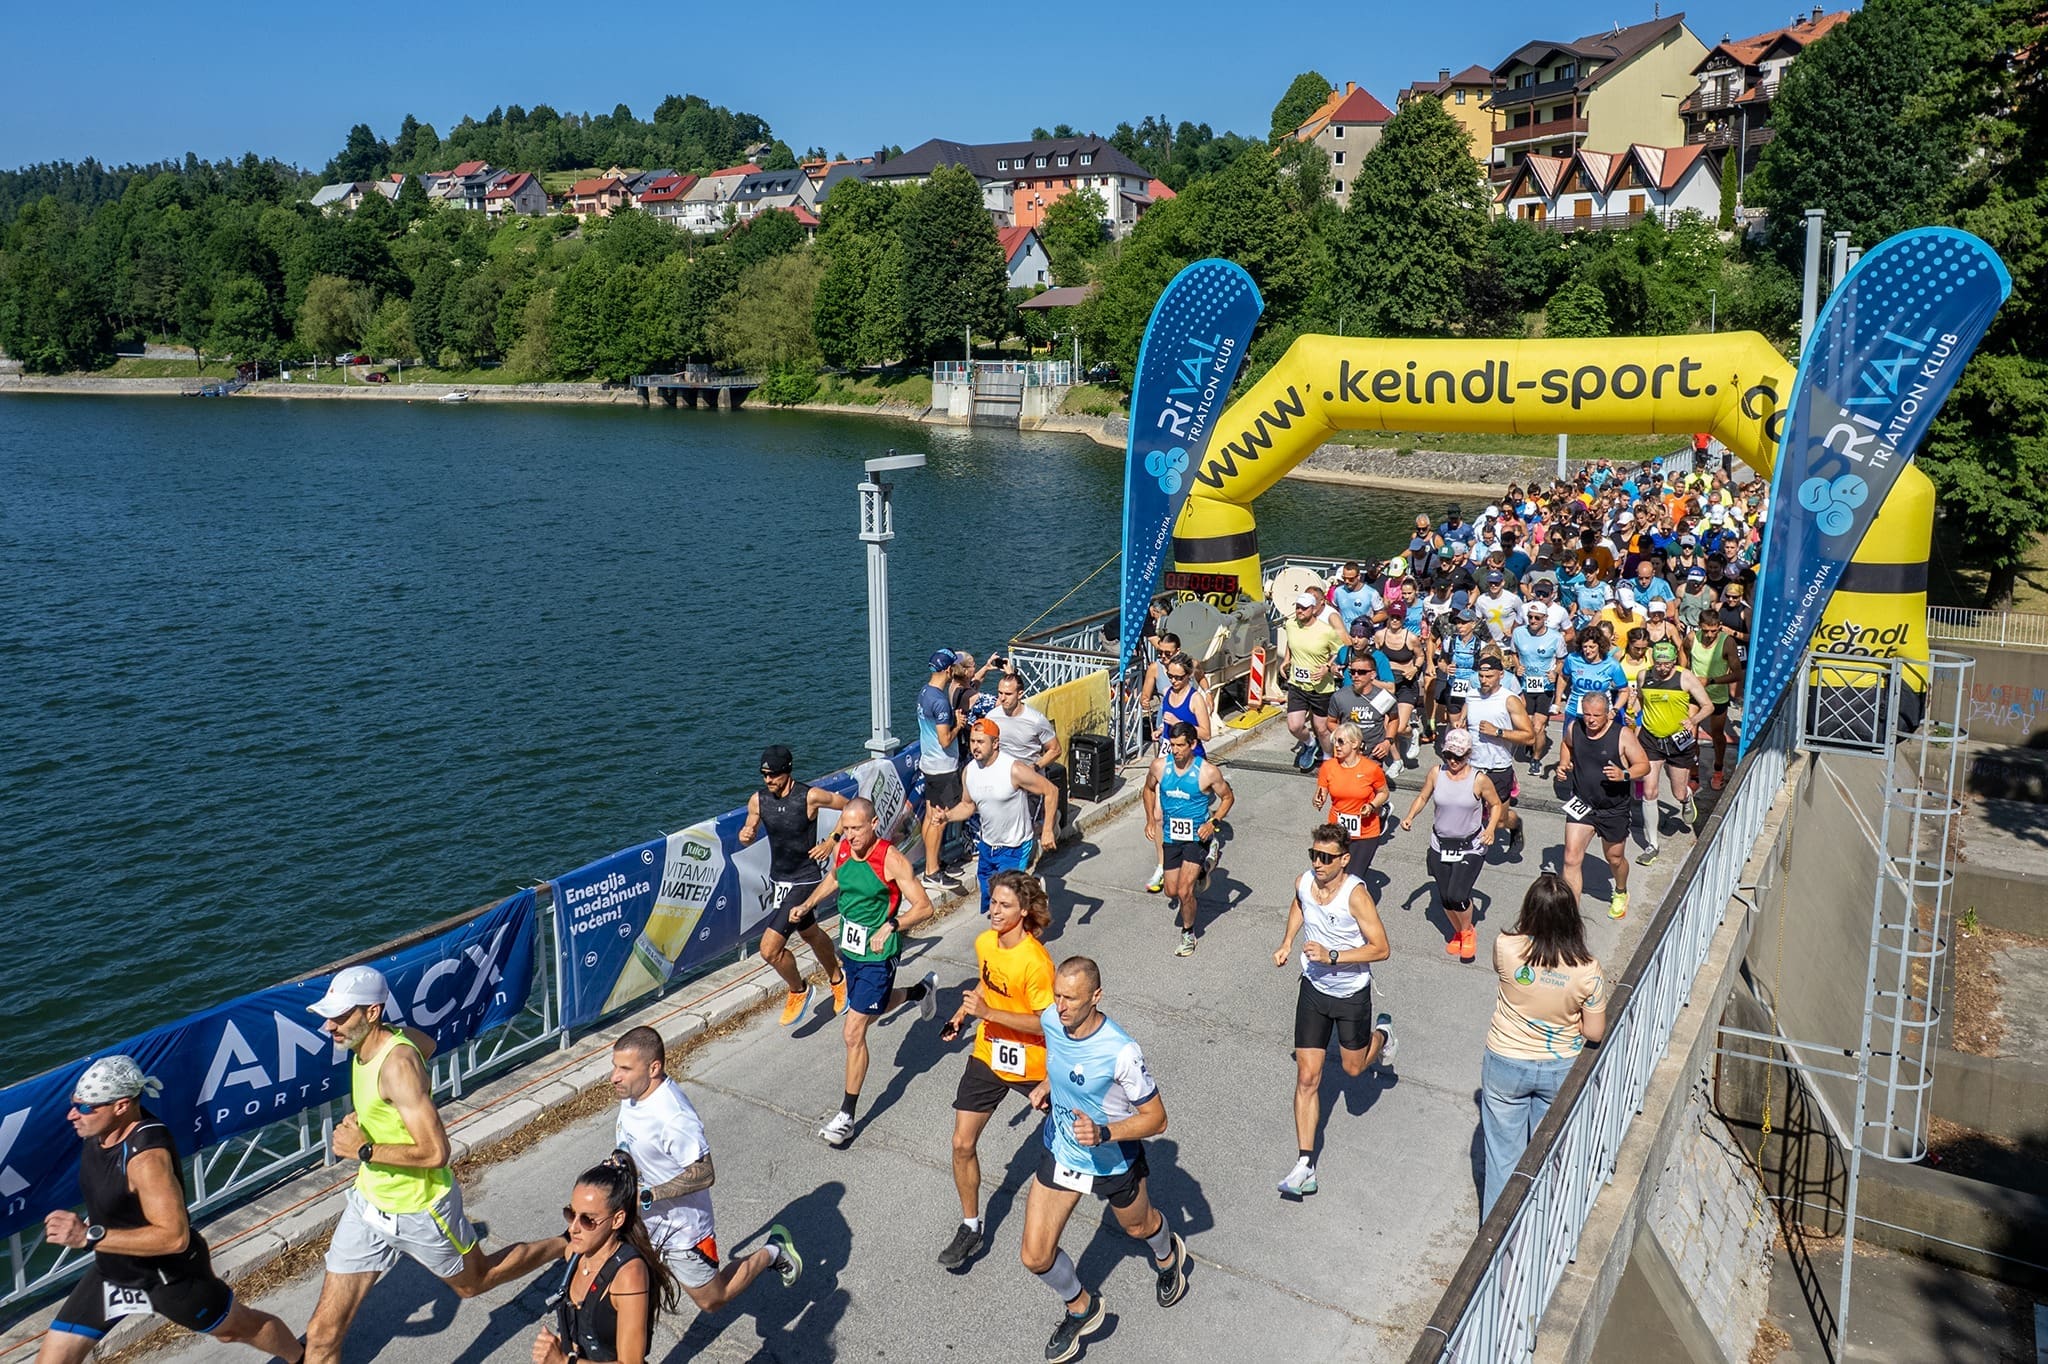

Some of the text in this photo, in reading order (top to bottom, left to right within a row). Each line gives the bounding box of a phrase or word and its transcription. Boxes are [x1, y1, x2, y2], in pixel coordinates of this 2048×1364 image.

[1188, 338, 1235, 442] TRIATLON KLUB
[1868, 332, 1958, 470] TRIATLON KLUB
[1143, 516, 1171, 582] RIJEKA CROATIA
[1294, 584, 1299, 592] 2
[1781, 564, 1831, 647] RIJEKA CROATIA
[1295, 667, 1309, 679] 255
[1527, 679, 1542, 688] 284
[1576, 677, 1603, 690] CRO
[1453, 682, 1468, 692] 234
[1570, 800, 1588, 815] 120
[1172, 820, 1191, 834] 293
[666, 861, 719, 883] VITAMIN
[565, 872, 626, 904] Energija
[661, 880, 712, 902] WATER
[574, 881, 650, 918] nadahnuta
[569, 905, 623, 936] voćem!
[847, 927, 861, 946] 64
[1540, 976, 1566, 988] KOTAR
[999, 1045, 1018, 1065] 66
[194, 1077, 330, 1133] SPORTS
